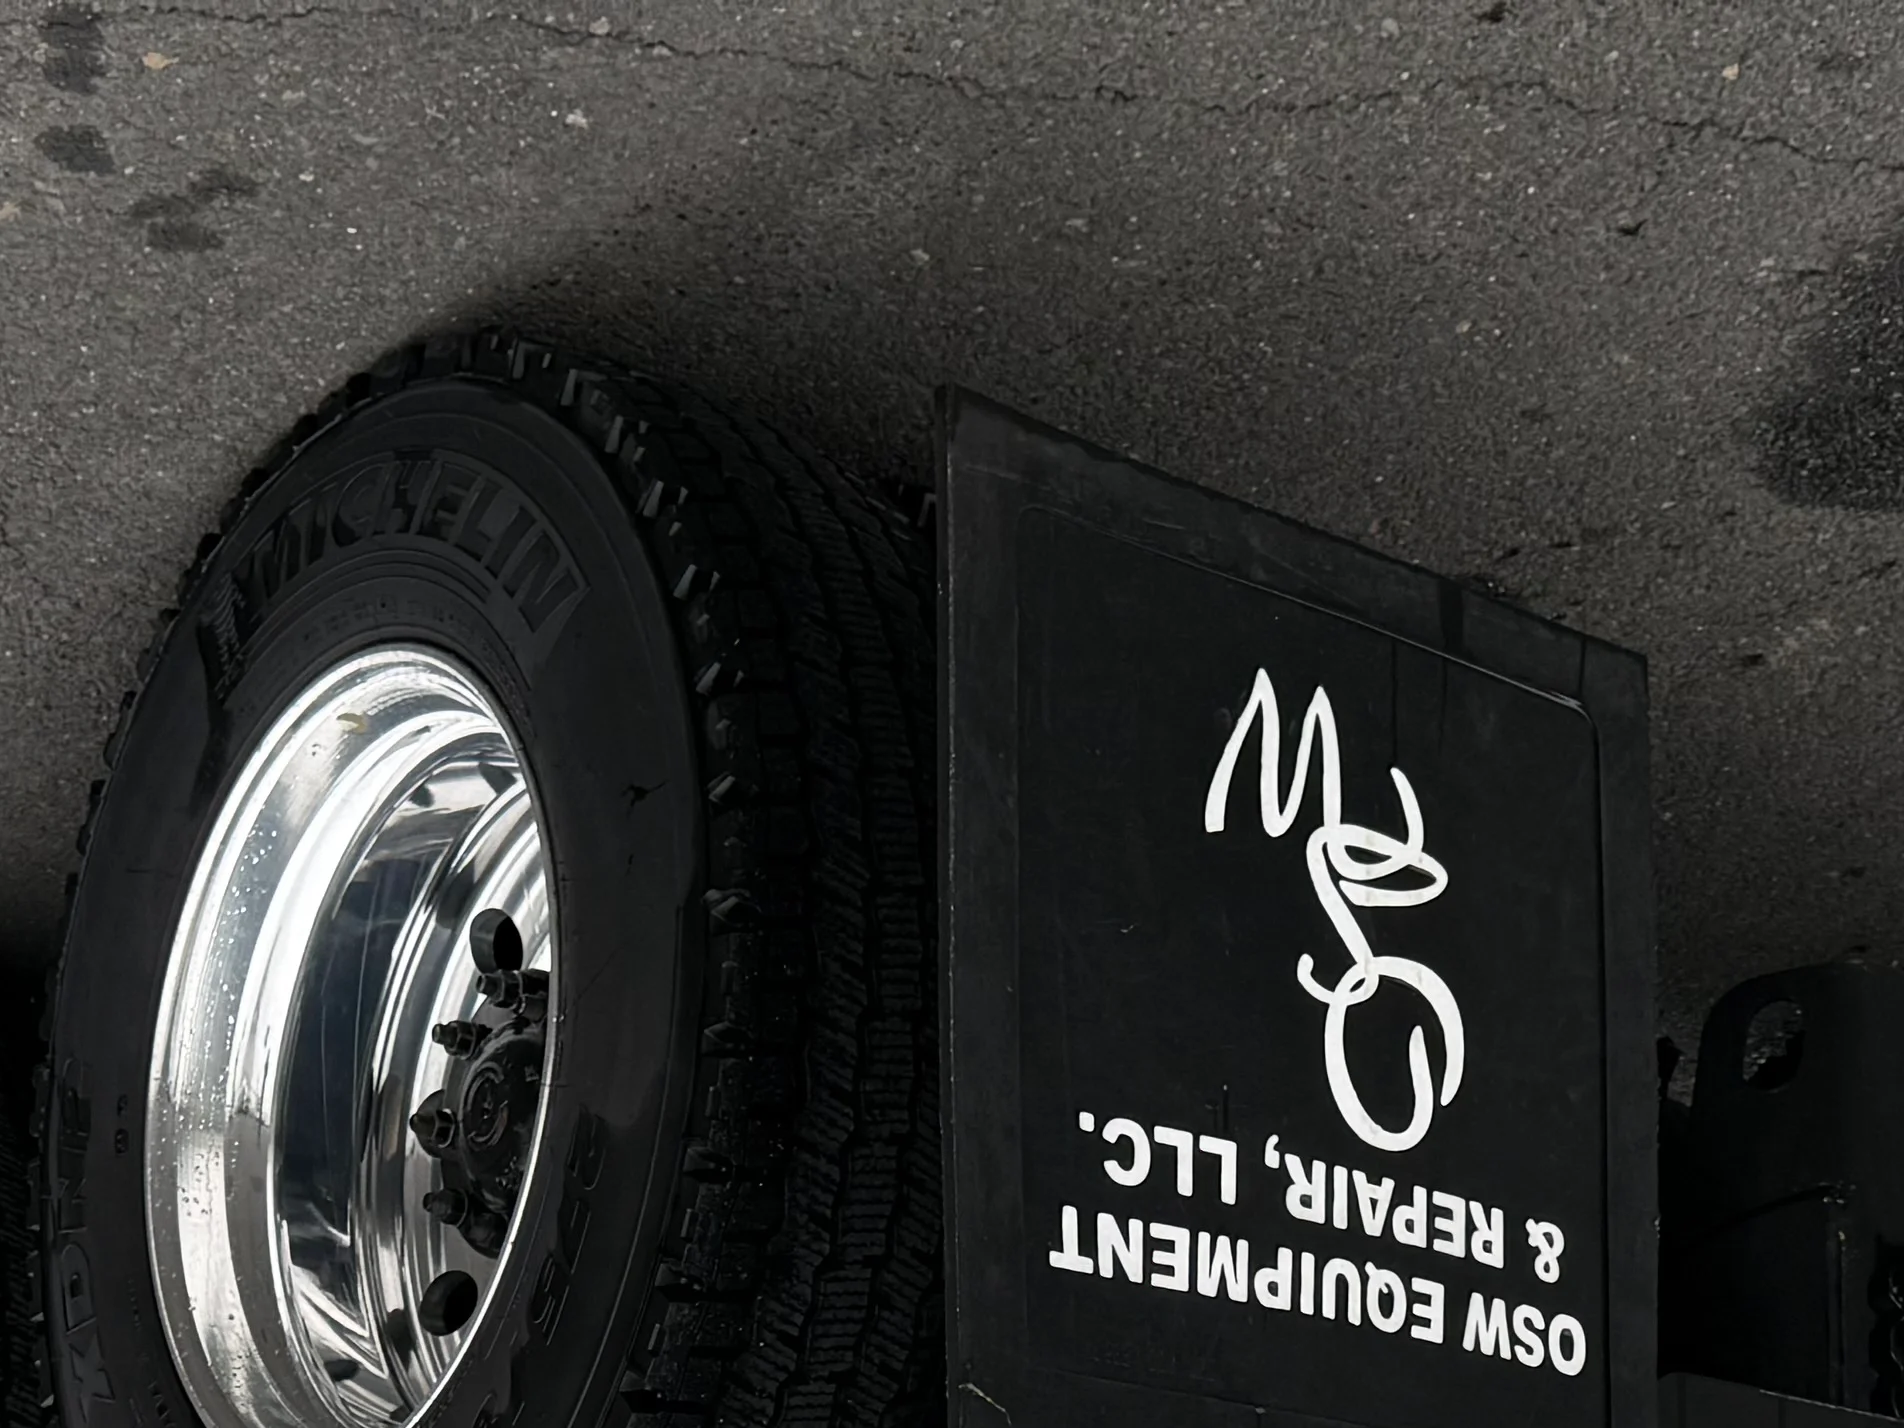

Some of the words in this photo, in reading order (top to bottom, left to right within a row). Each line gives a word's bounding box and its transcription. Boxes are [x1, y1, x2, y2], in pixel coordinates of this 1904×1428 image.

[1079, 1112, 1237, 1204] LLC.
[1265, 1135, 1503, 1268] REPAIR,
[1050, 1206, 1444, 1343] EQUIPMENT
[1526, 1219, 1564, 1283] &
[1463, 1293, 1586, 1375] OSW
